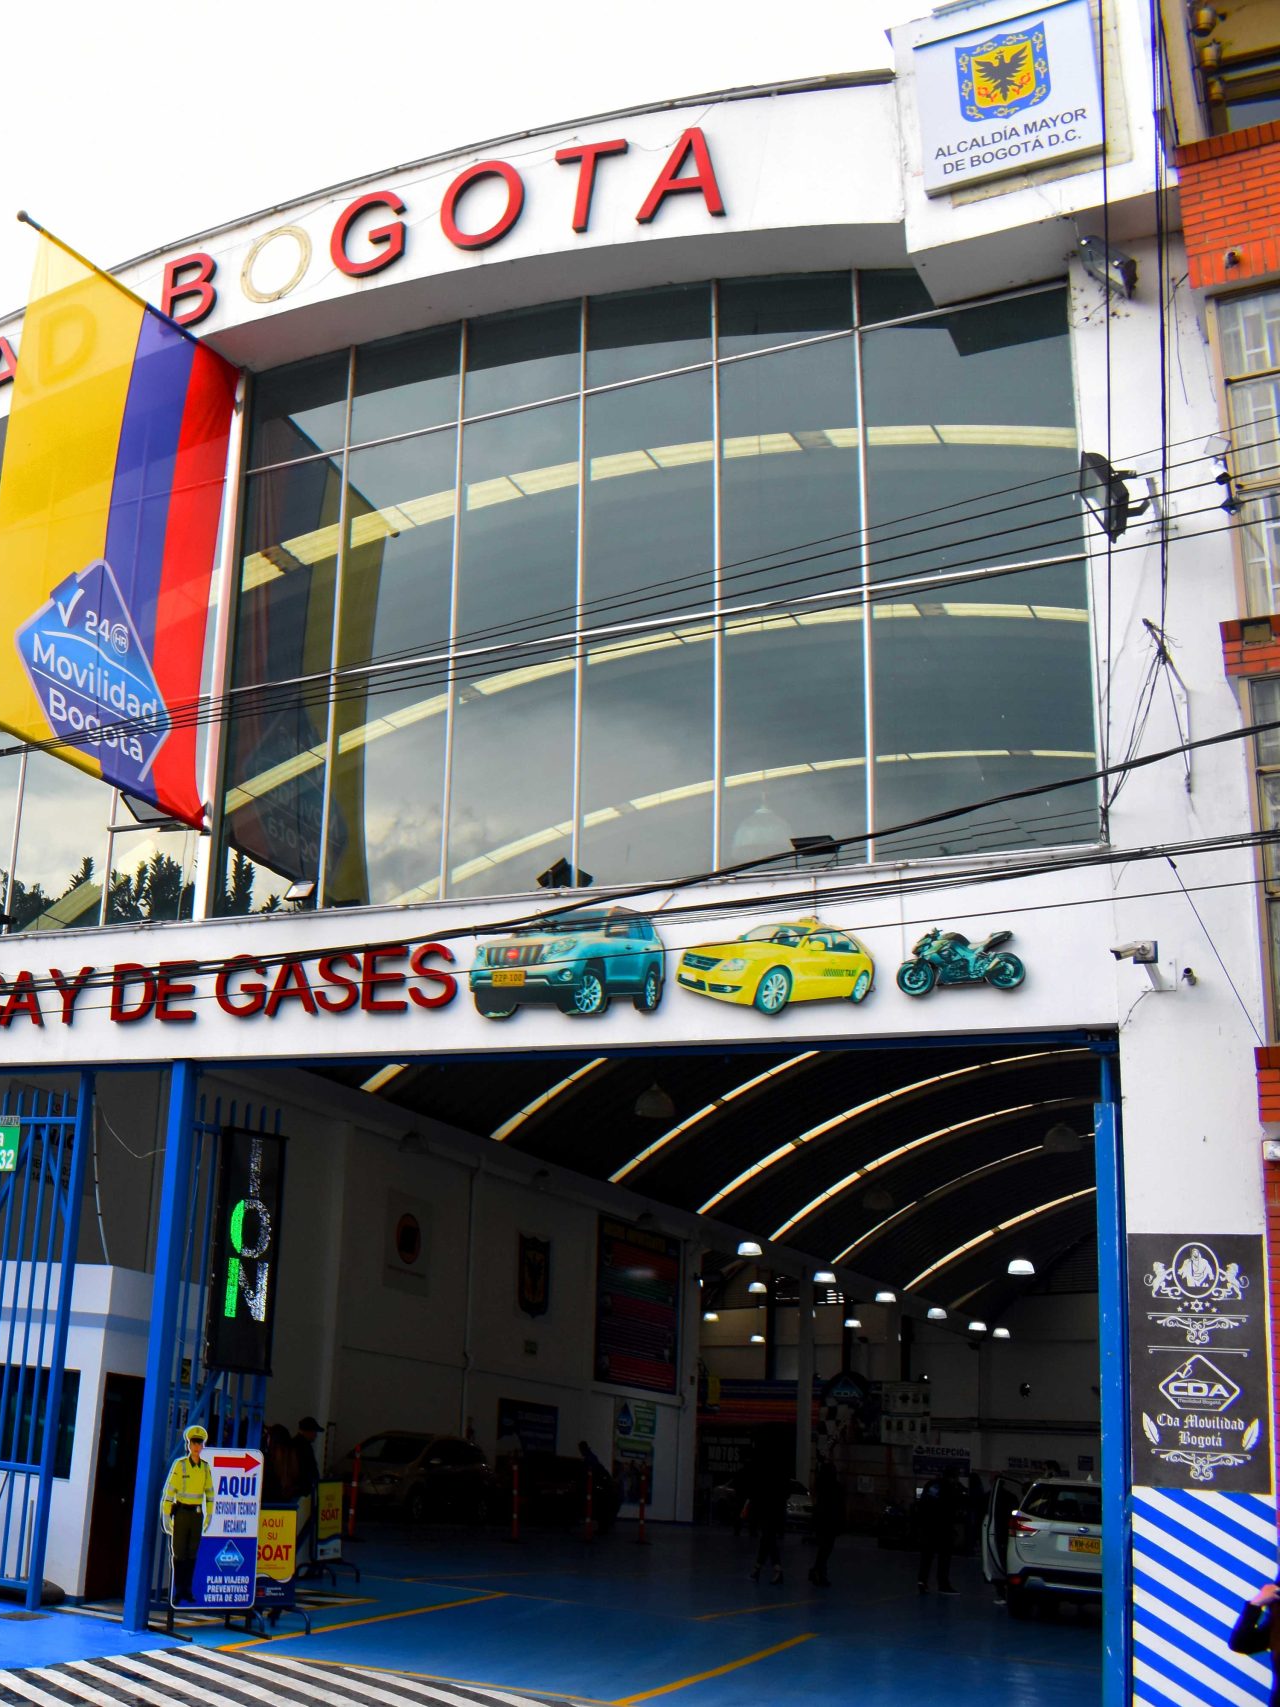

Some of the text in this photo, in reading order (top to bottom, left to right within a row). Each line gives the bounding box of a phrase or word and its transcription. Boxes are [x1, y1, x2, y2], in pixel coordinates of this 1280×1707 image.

[934, 107, 1087, 160] ALCALDÍA MAYOR
[942, 130, 1082, 175] DE BOGOTÁ D.C.
[158, 126, 726, 332] BOGOTA
[84, 610, 110, 643] 24
[33, 633, 158, 723] Movilidad
[110, 960, 197, 1024] DE
[215, 942, 458, 1018] GASES
[1168, 1381, 1230, 1398] CDA
[1157, 1413, 1245, 1431] Cda Movilidad
[218, 1473, 258, 1498] AQUÍ
[267, 1531, 278, 1541] SU
[206, 1575, 250, 1585] PLAN VIAJERO
[207, 1584, 248, 1594] PREVENTIVAS
[203, 1593, 250, 1603] VENTA DE SOAT
